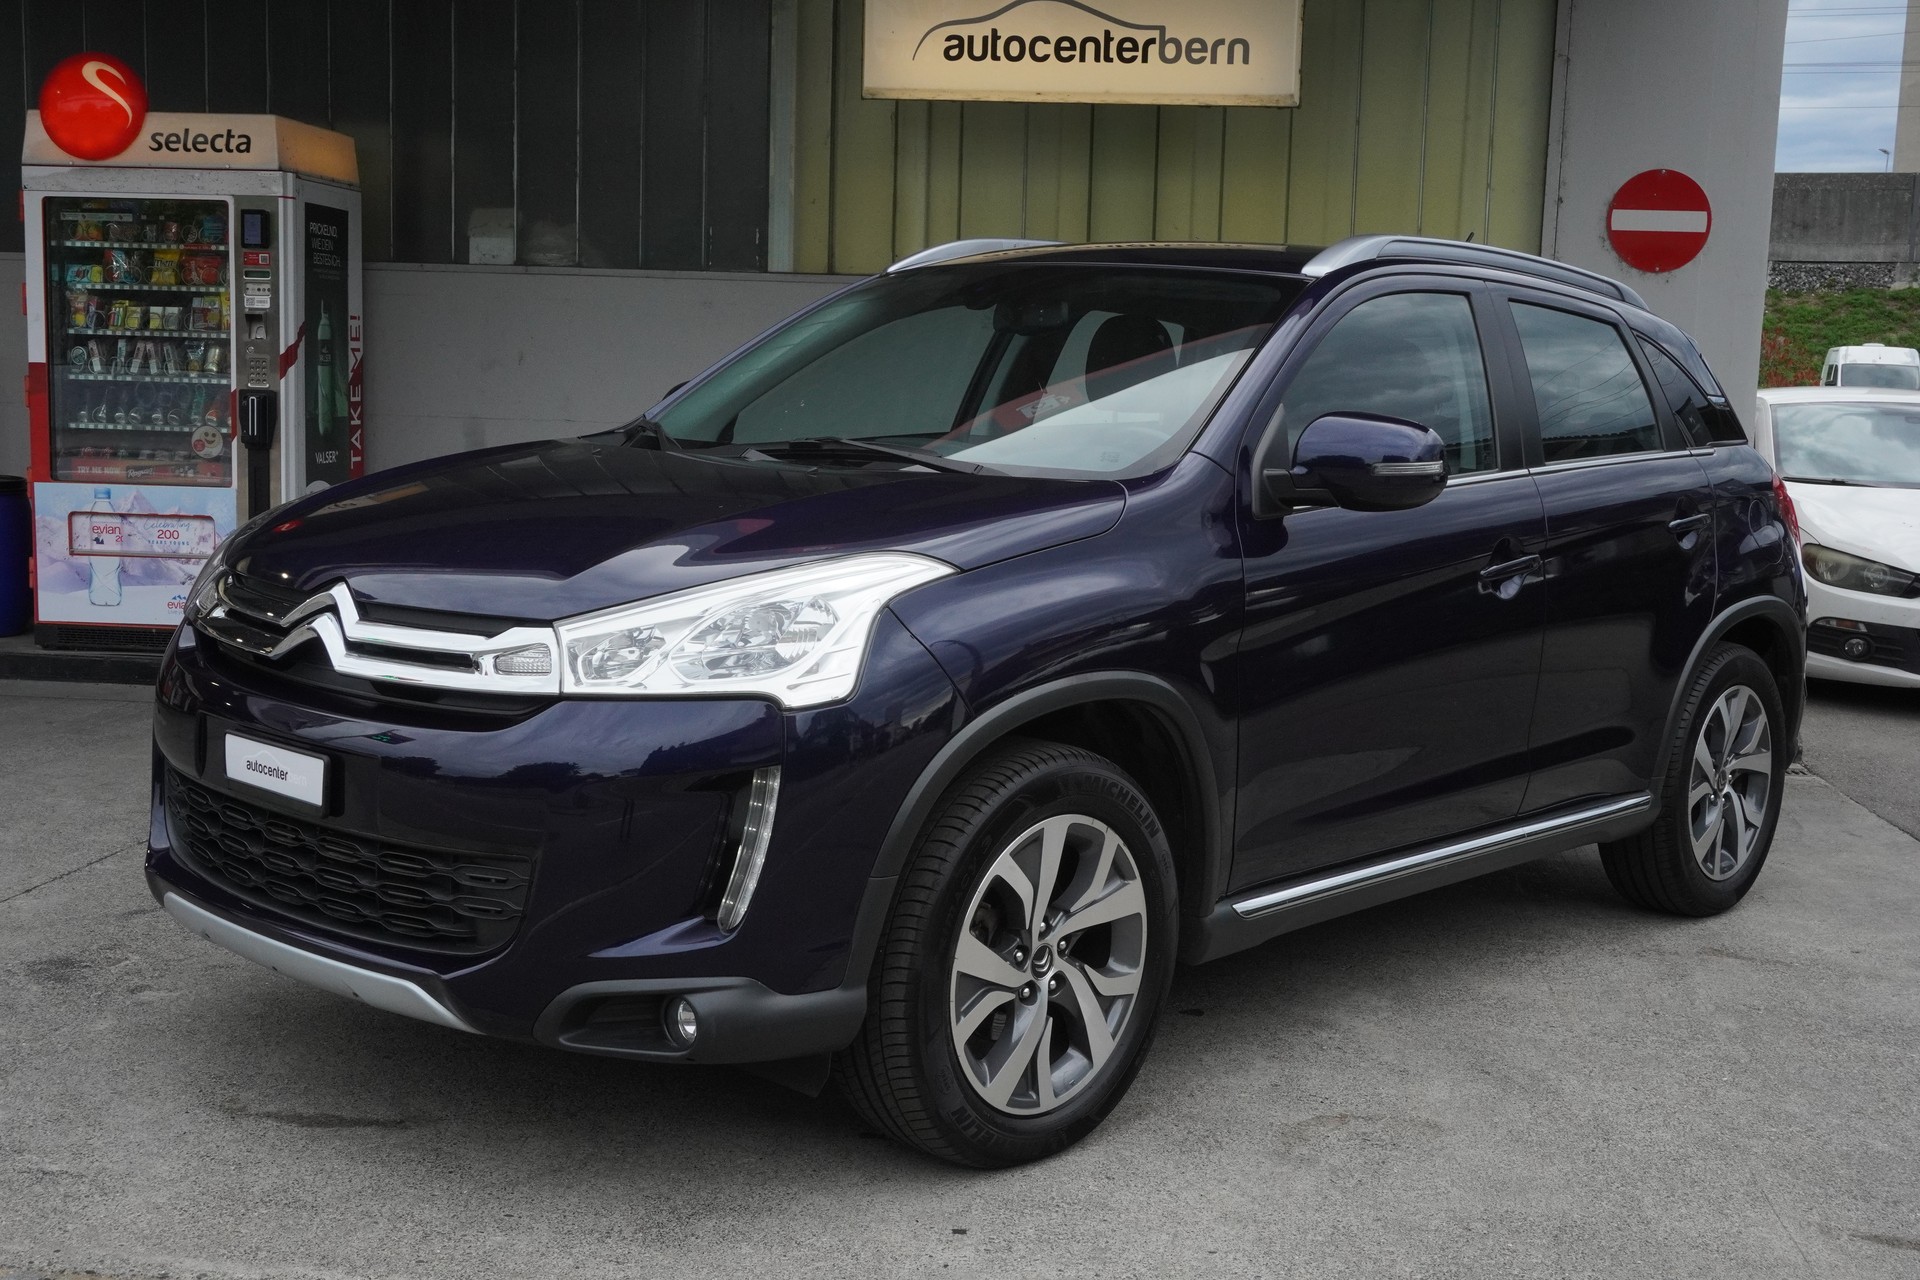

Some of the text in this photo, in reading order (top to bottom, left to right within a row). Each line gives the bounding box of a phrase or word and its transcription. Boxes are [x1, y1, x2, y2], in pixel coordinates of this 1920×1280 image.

[149, 128, 252, 153] selecta
[349, 315, 362, 470] TAKE ME!
[77, 465, 120, 474] TRY ME NOW
[92, 524, 121, 535] evian
[144, 518, 191, 531] Celebrating
[157, 529, 180, 540] 200
[167, 600, 186, 610] evia
[1085, 774, 1161, 839] MICHELIN
